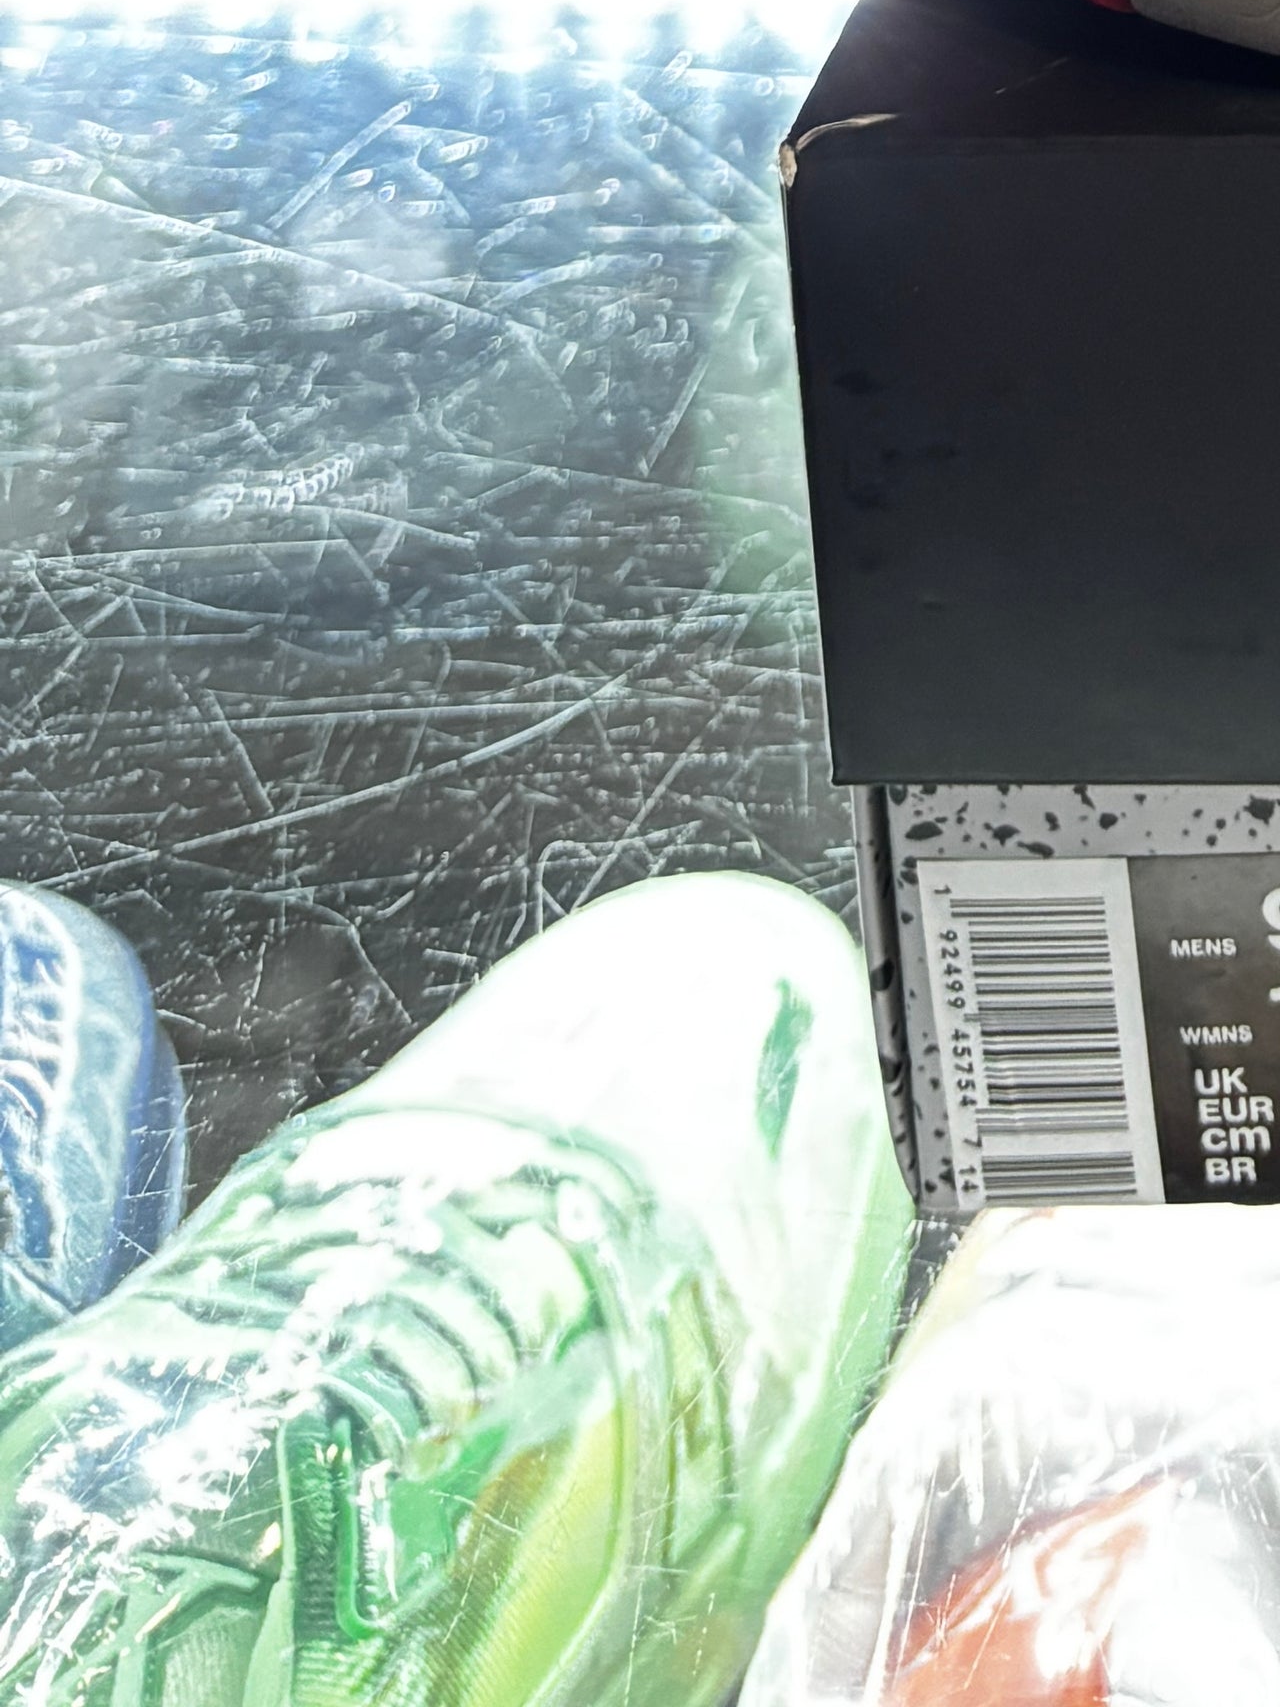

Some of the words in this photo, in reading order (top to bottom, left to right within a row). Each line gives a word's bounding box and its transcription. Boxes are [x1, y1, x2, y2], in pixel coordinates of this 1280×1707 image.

[1170, 938, 1237, 957] MENS
[939, 929, 966, 1009] 92499
[1179, 1024, 1253, 1044] WMNS
[951, 1029, 977, 1107] 45754
[1194, 1067, 1248, 1094] UK
[1198, 1095, 1275, 1125] EUR
[1204, 1156, 1257, 1183] BR
